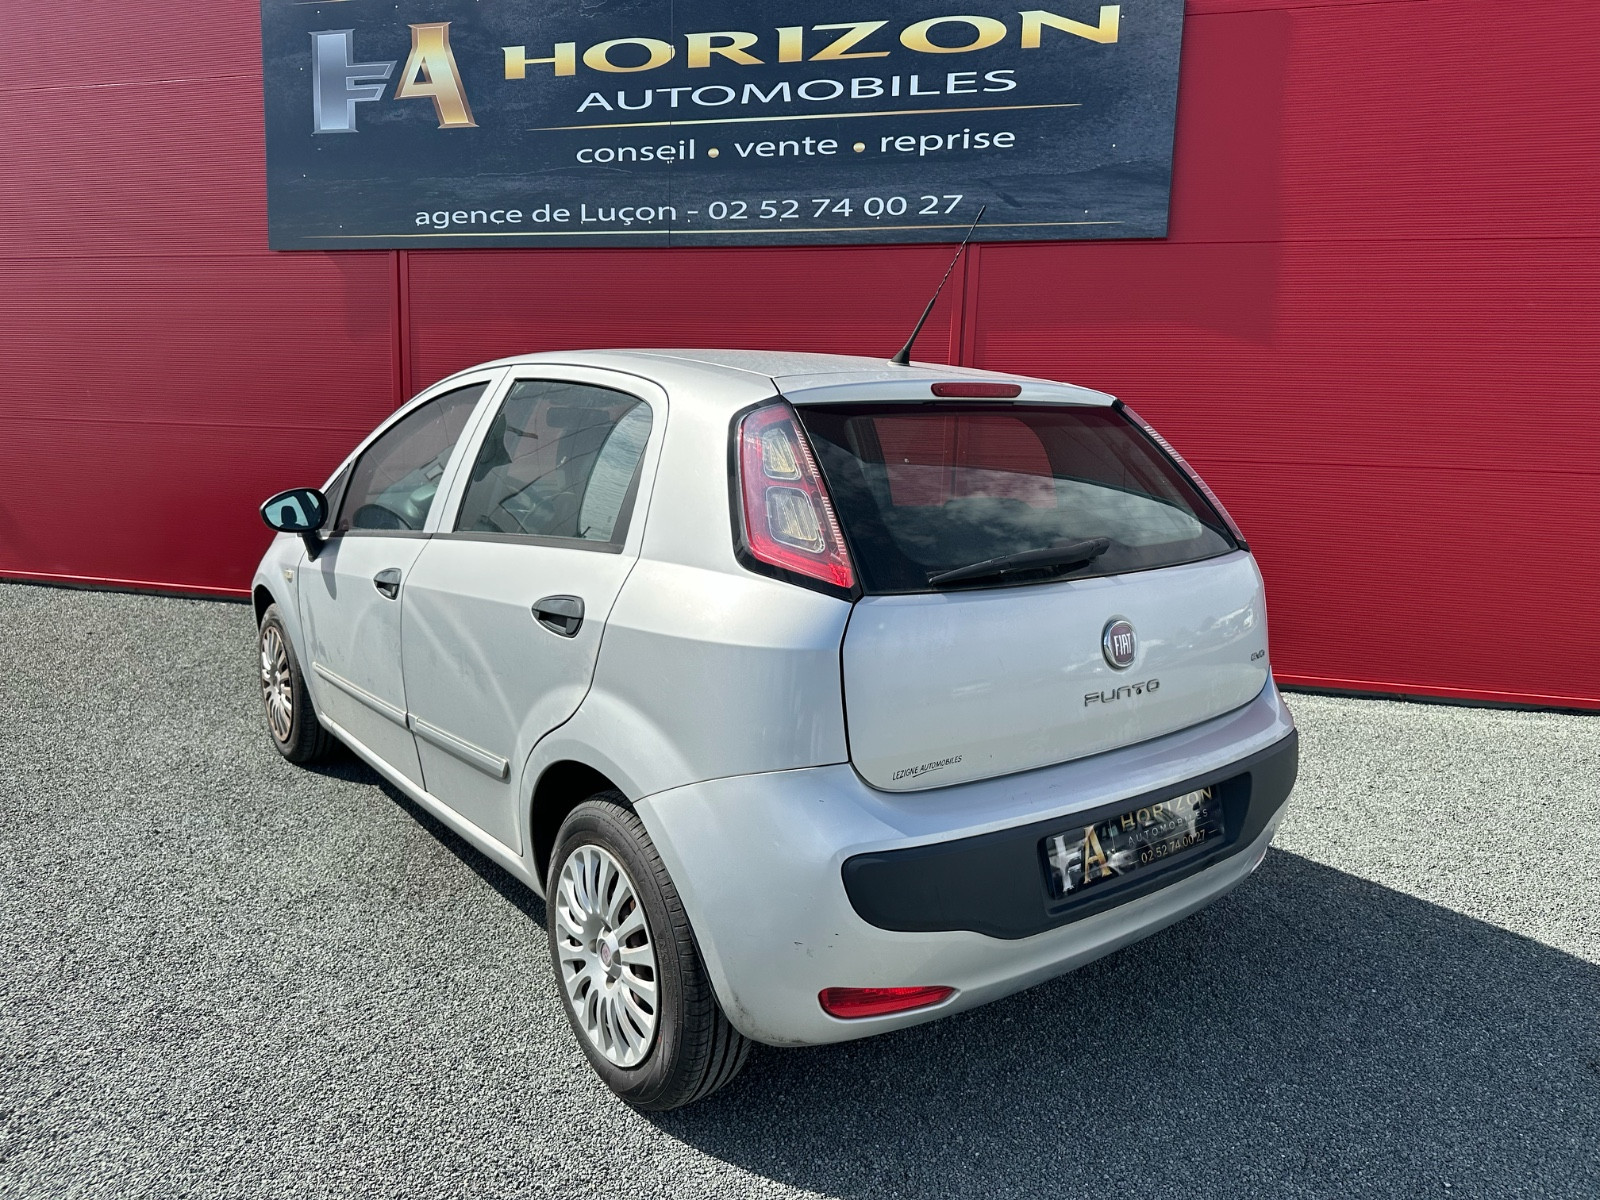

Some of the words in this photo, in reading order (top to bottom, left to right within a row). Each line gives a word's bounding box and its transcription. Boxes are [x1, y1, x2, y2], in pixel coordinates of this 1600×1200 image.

[502, 5, 1121, 80] HORIZON
[576, 70, 1017, 113] AUTOMOBILES
[576, 139, 696, 164] conseil
[734, 135, 838, 158] vente
[880, 128, 1016, 157] reprise
[415, 207, 523, 229] agence
[532, 204, 571, 224] de
[581, 203, 677, 227] Luçon
[708, 201, 748, 220] 02
[759, 200, 799, 219] 52
[812, 198, 853, 218] 74
[863, 197, 908, 217] 00
[918, 194, 964, 215] 27
[1113, 633, 1132, 656] FIAT
[1084, 678, 1160, 707] PUNTO
[920, 755, 963, 772] AUTOMOBILES
[1120, 786, 1213, 832] HORIZON
[1128, 809, 1209, 847] AUTOMOBILES
